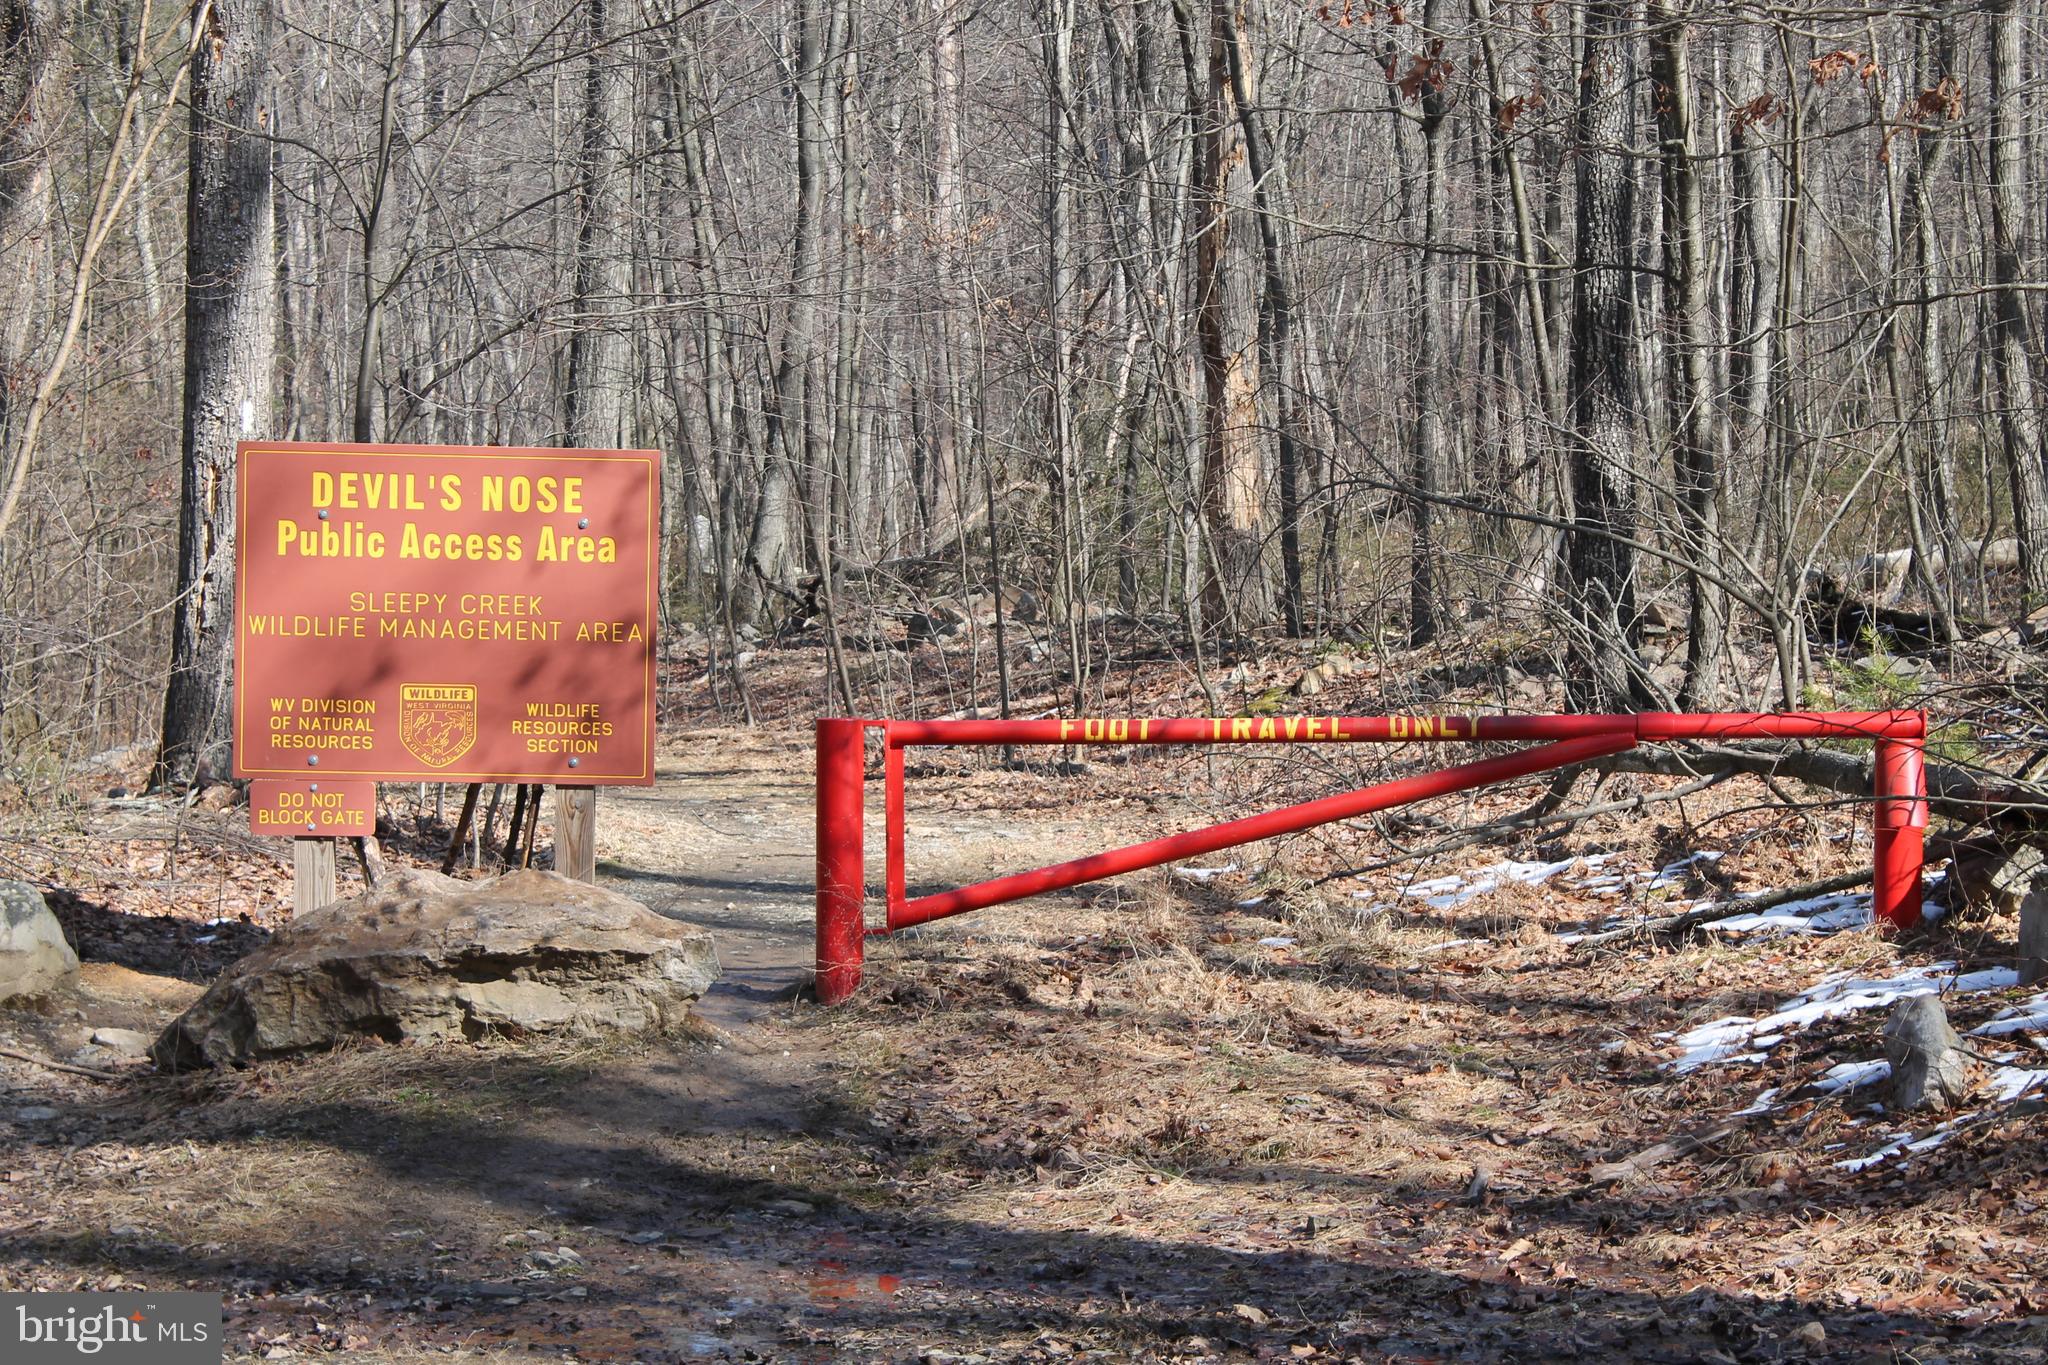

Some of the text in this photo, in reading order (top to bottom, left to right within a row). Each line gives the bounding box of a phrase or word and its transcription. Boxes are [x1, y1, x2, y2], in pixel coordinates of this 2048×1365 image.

[312, 471, 584, 514] DEVIL'S NOSE
[277, 520, 617, 564] Public Access Area
[350, 591, 543, 616] SLEEPY CREEK
[248, 615, 643, 643] WILDLIFE MANAGEMENT AREA
[409, 688, 468, 700] WILDLIFE
[270, 698, 376, 715] WV DIVISION
[526, 703, 600, 719] WILDLIFE
[270, 716, 375, 733] OF NATURAL
[512, 720, 613, 736] RESOURCES
[1060, 715, 1481, 741] FOOT TRAVEL ONLY
[271, 733, 374, 750] RESOURCES
[527, 738, 599, 754] SECTION
[278, 792, 345, 808] DO NOT
[258, 809, 365, 826] BLOCK GATE
